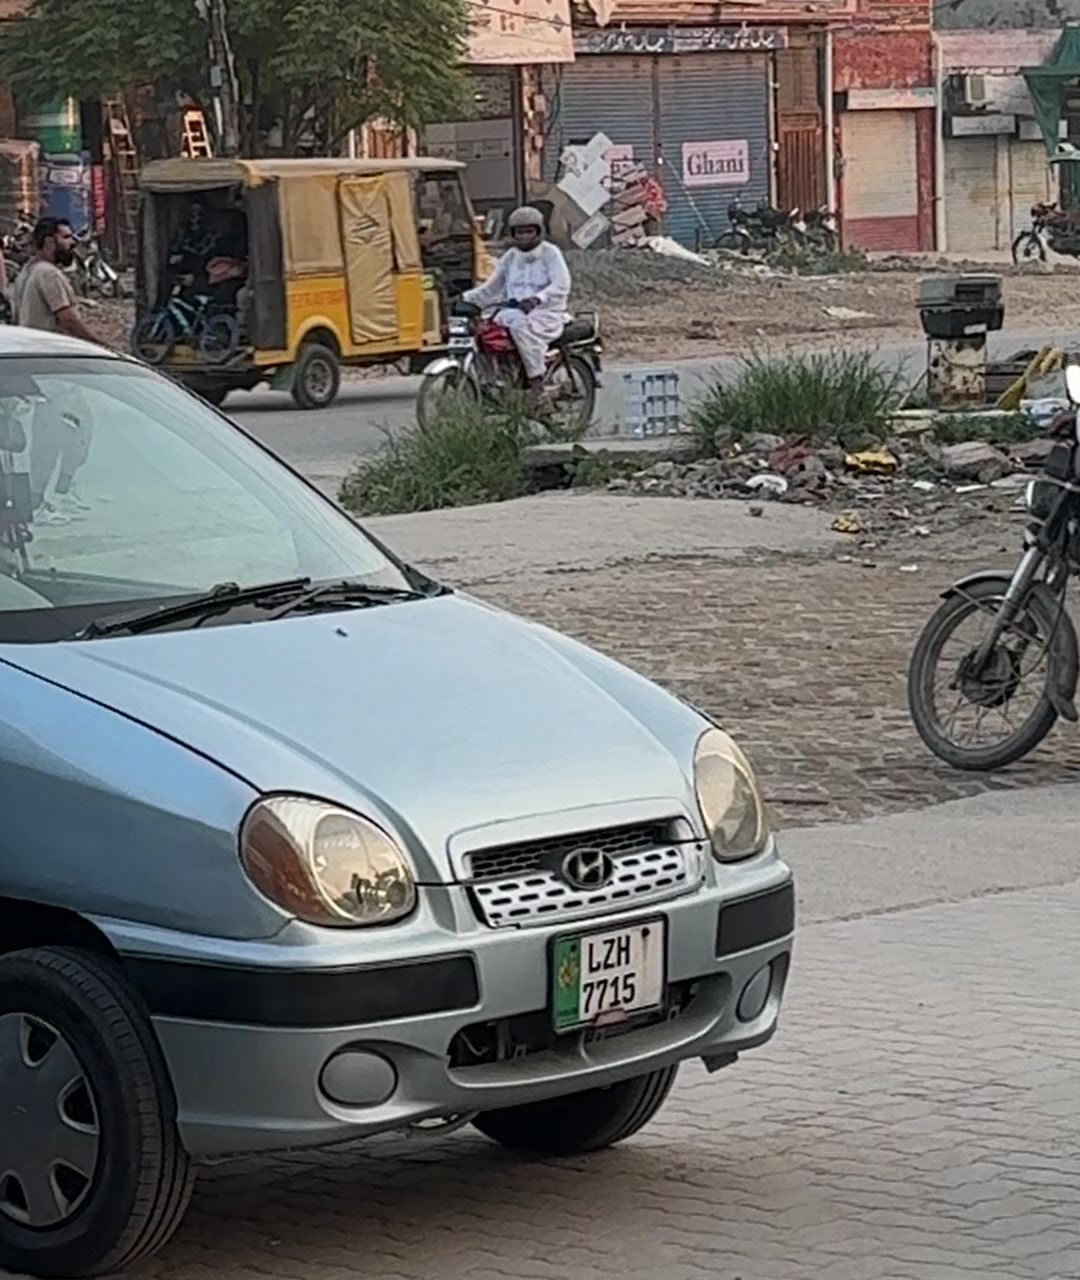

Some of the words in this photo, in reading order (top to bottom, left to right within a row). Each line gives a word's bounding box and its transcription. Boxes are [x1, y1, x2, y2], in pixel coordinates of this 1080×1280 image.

[687, 150, 745, 177] Ghani
[588, 935, 631, 974] LZH
[583, 972, 636, 1014] 7715
